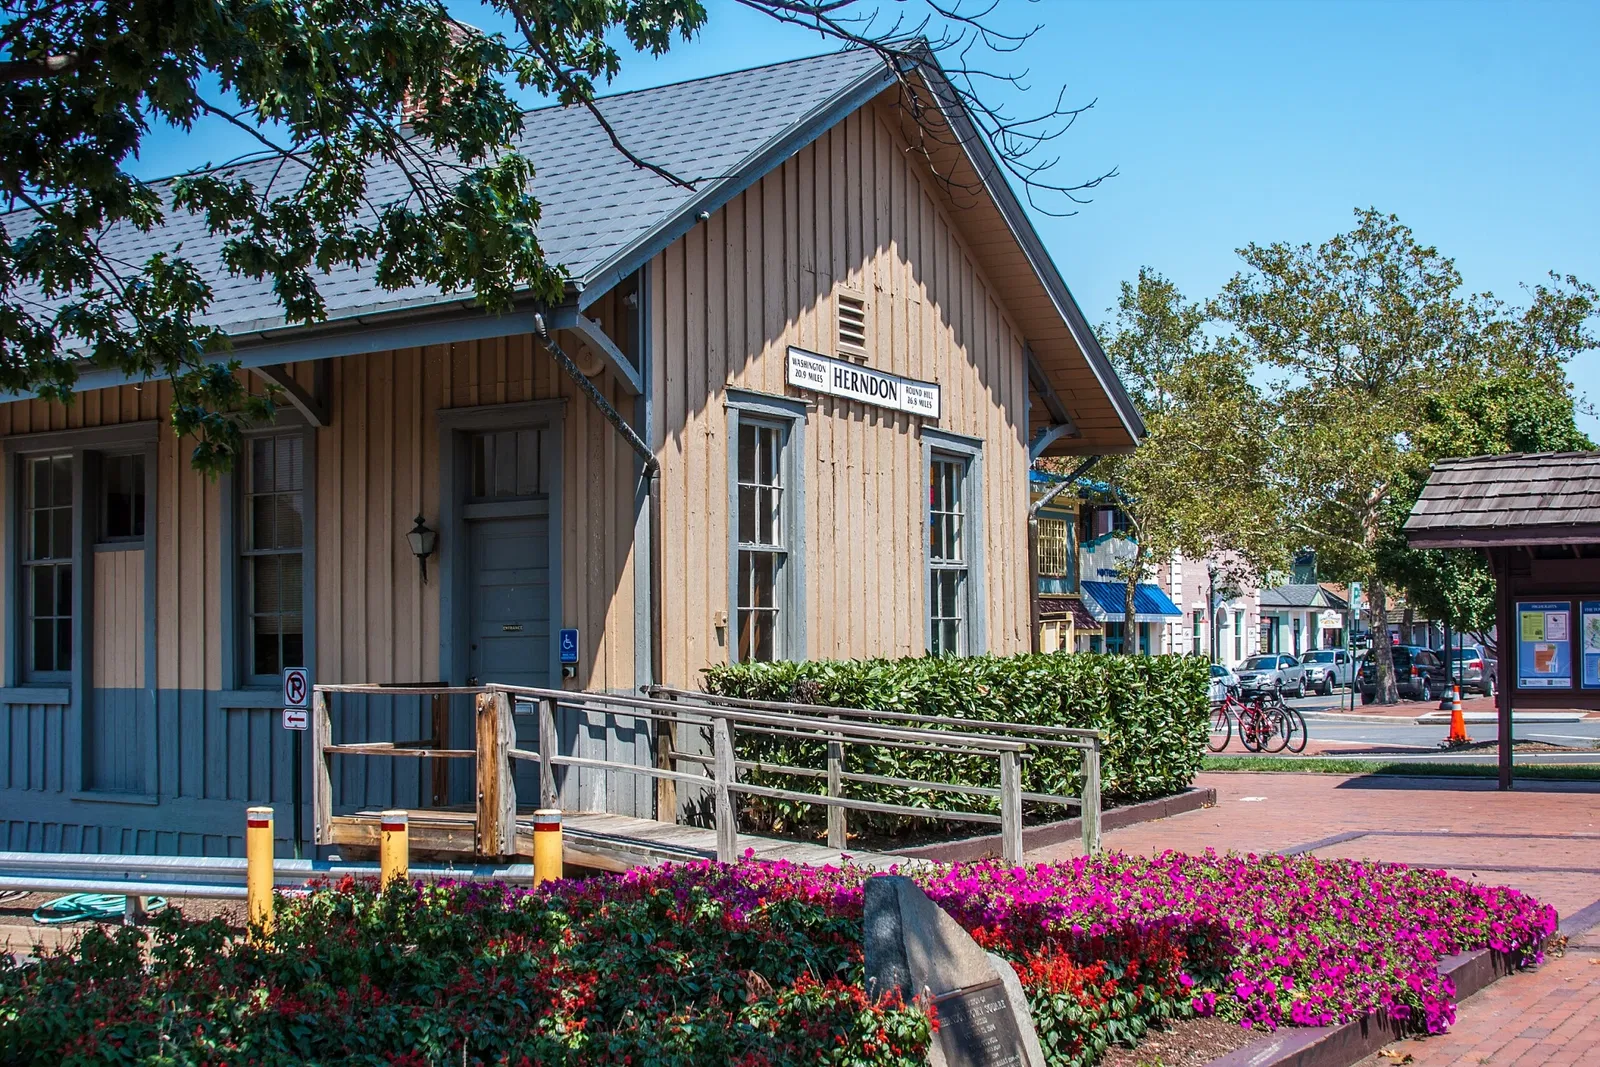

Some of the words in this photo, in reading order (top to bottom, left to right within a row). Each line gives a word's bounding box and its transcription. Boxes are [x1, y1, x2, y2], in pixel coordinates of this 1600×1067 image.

[792, 357, 826, 373] WASHINGTON
[795, 369, 806, 379] 20.9
[808, 372, 823, 383] MILES
[834, 367, 897, 401] HERNDON
[906, 386, 922, 396] ROUND
[924, 390, 933, 399] HILL
[919, 399, 932, 409] MILES
